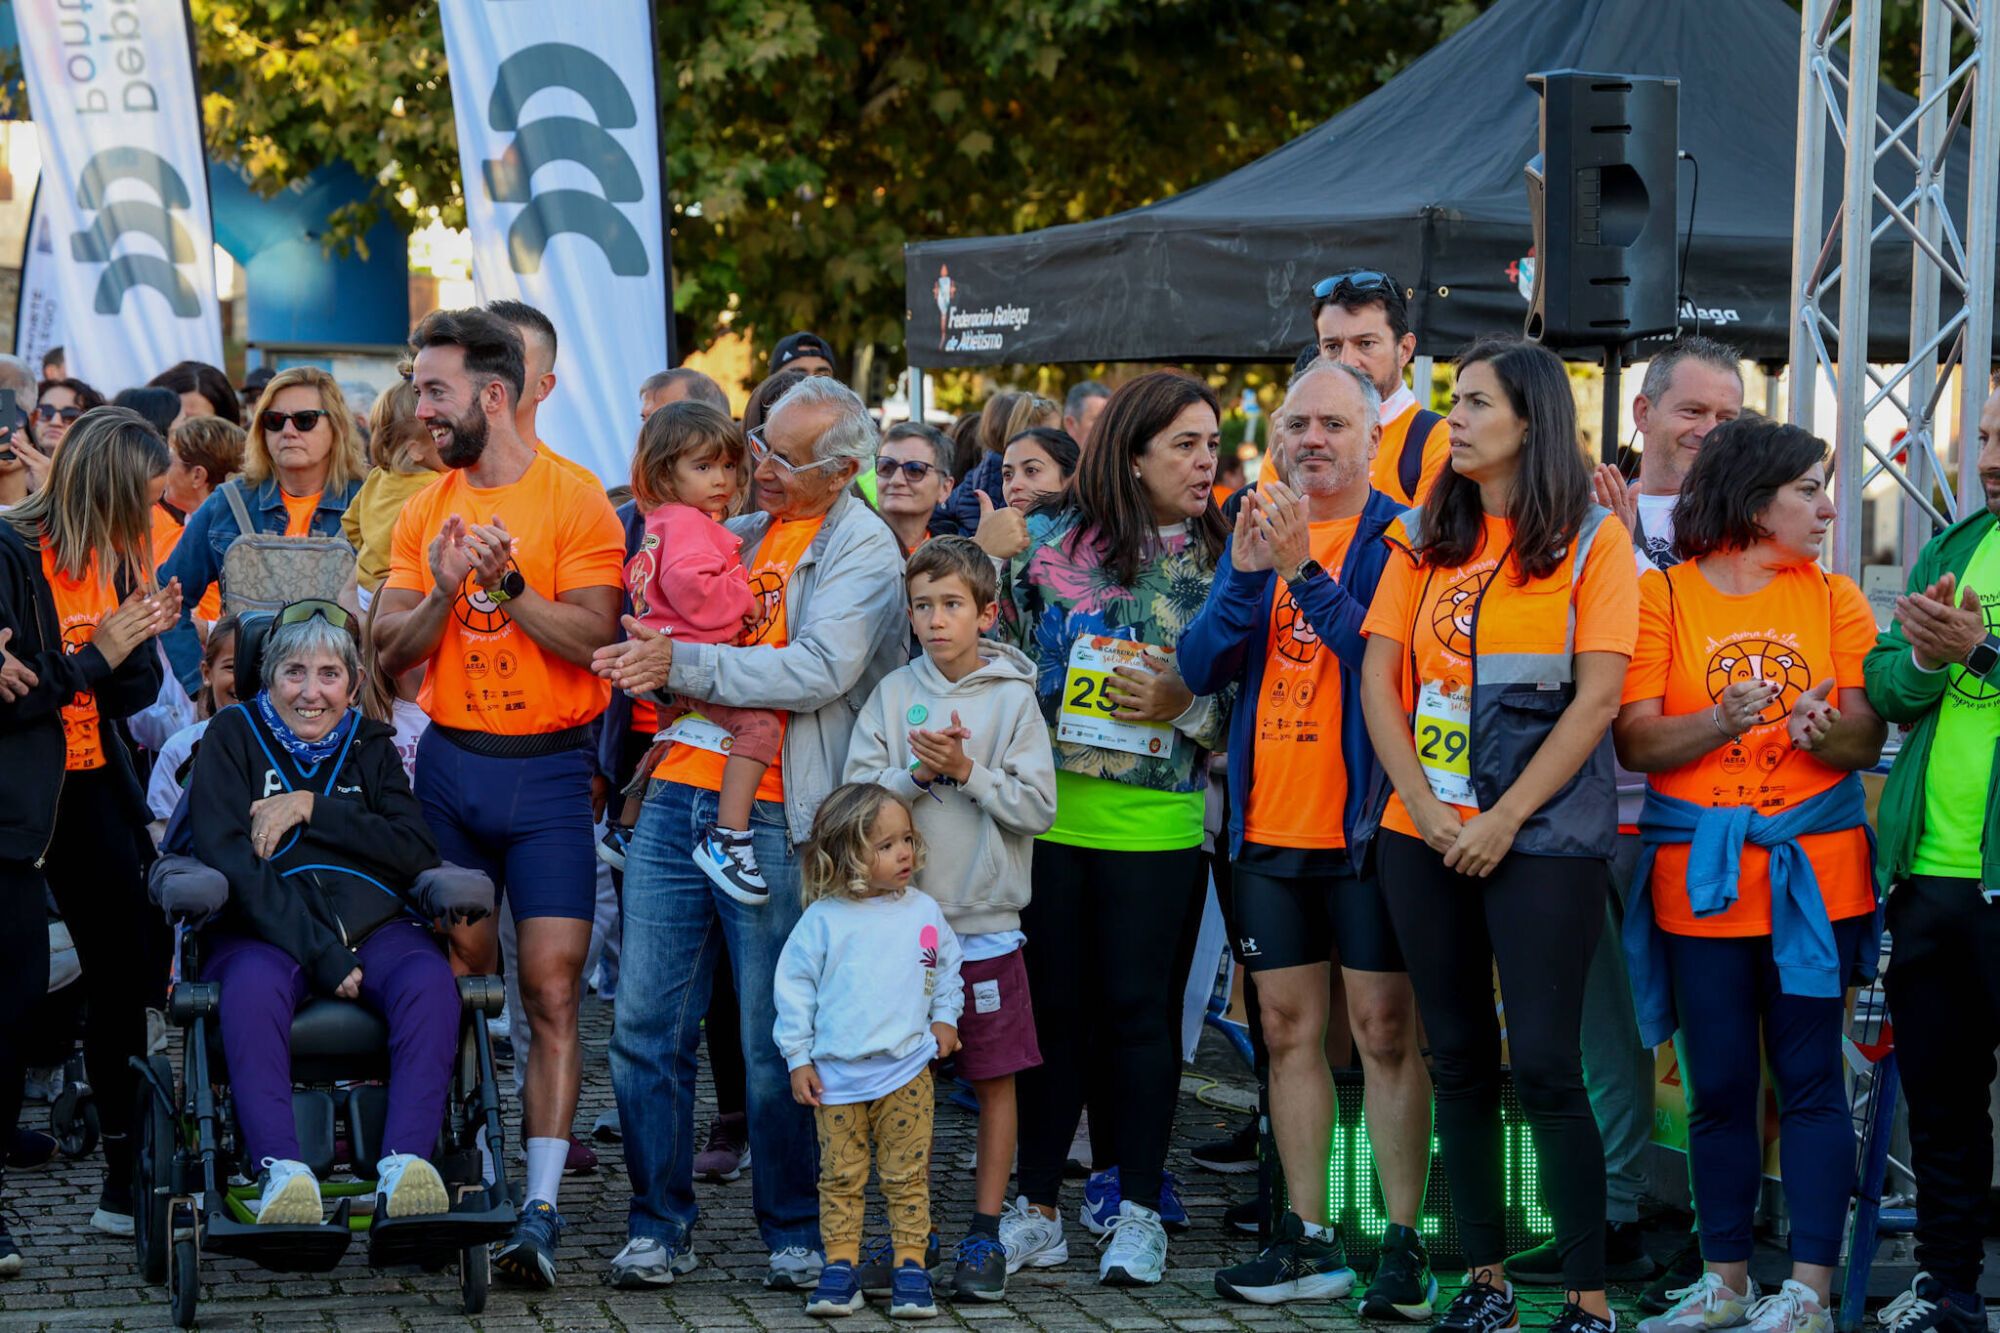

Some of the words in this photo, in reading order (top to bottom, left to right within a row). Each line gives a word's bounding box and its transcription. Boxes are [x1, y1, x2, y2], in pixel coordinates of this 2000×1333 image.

[948, 306, 993, 329] Federación
[993, 303, 1030, 331] Galega
[1677, 302, 1740, 325] alega
[945, 335, 958, 352] de
[957, 330, 1003, 352] Atletismo
[1420, 725, 1471, 764] 29
